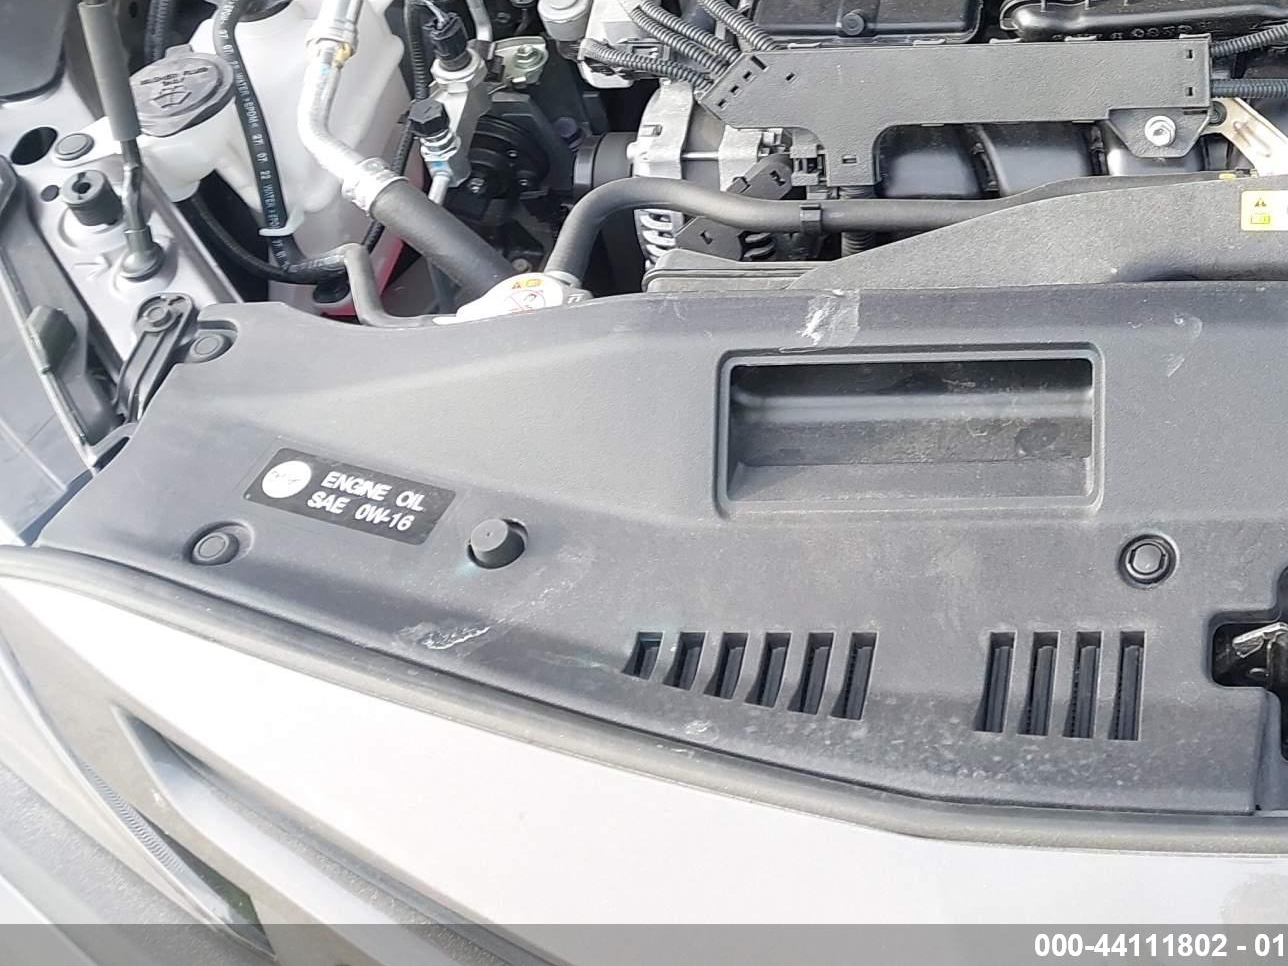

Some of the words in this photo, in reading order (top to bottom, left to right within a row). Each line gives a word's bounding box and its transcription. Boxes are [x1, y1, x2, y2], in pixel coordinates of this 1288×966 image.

[307, 491, 350, 515] SAE
[354, 503, 415, 531] 0W-16
[320, 471, 393, 502] ENGINE
[395, 490, 425, 511] OIL
